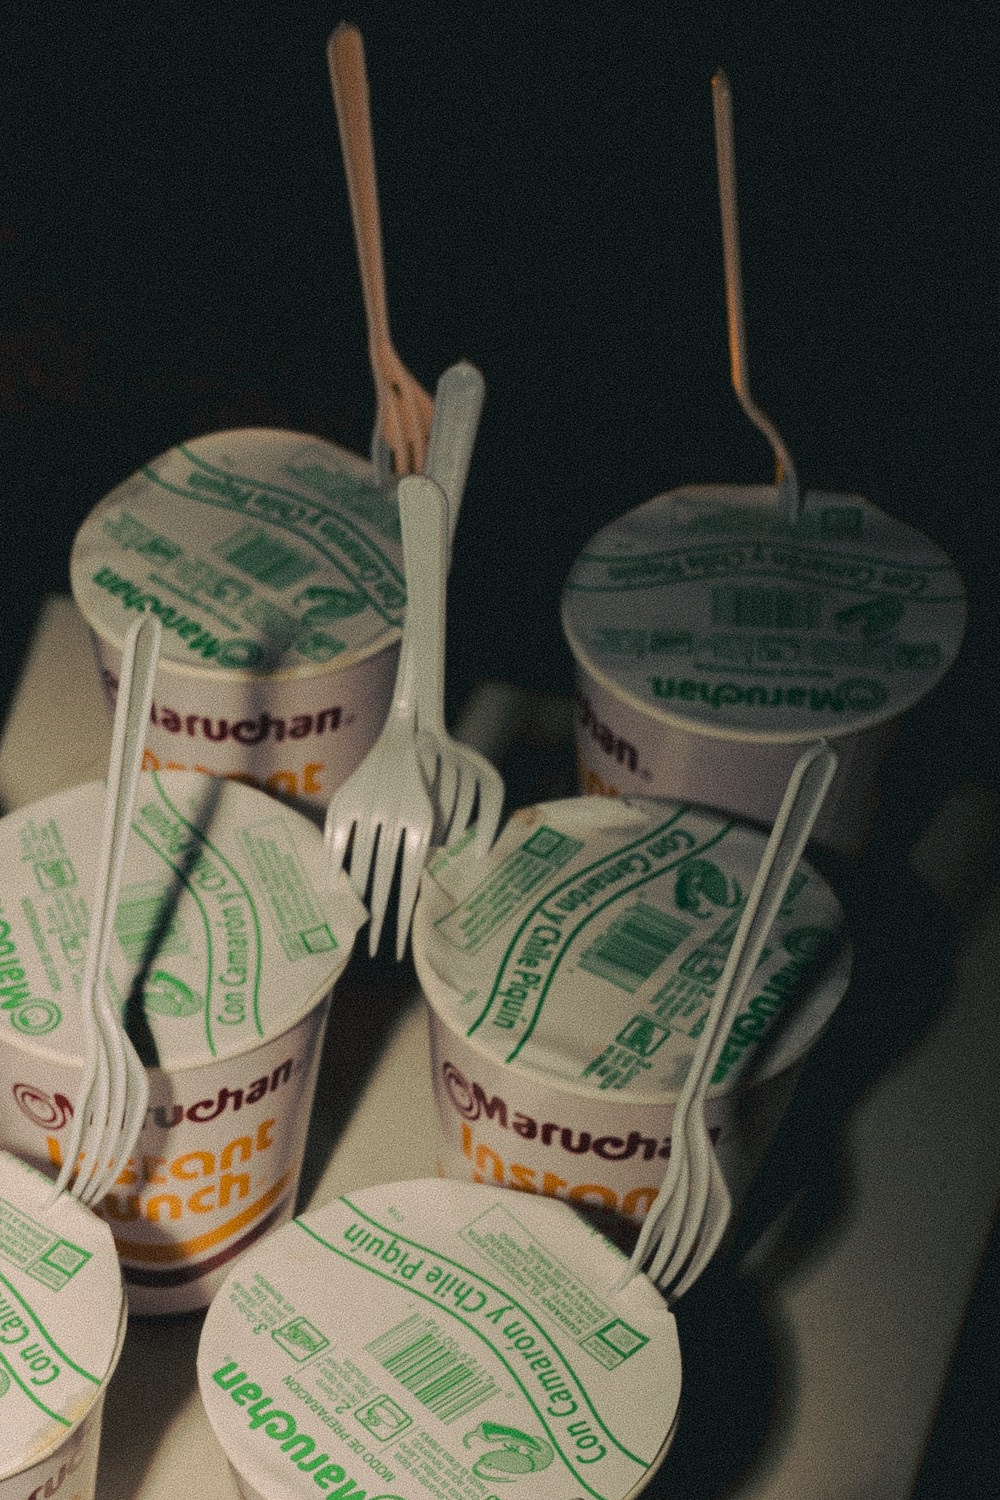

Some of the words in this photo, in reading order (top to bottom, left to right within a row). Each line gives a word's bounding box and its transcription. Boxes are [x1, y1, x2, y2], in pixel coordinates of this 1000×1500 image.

[150, 702, 342, 744] aruchan
[99, 1172, 251, 1223] unch
[342, 1224, 426, 1281] Piquín
[425, 1266, 489, 1314] Chile
[484, 1304, 517, 1326] y
[18, 1342, 61, 1387] Con
[502, 1320, 579, 1418] Camarón
[565, 1419, 606, 1467] Con
